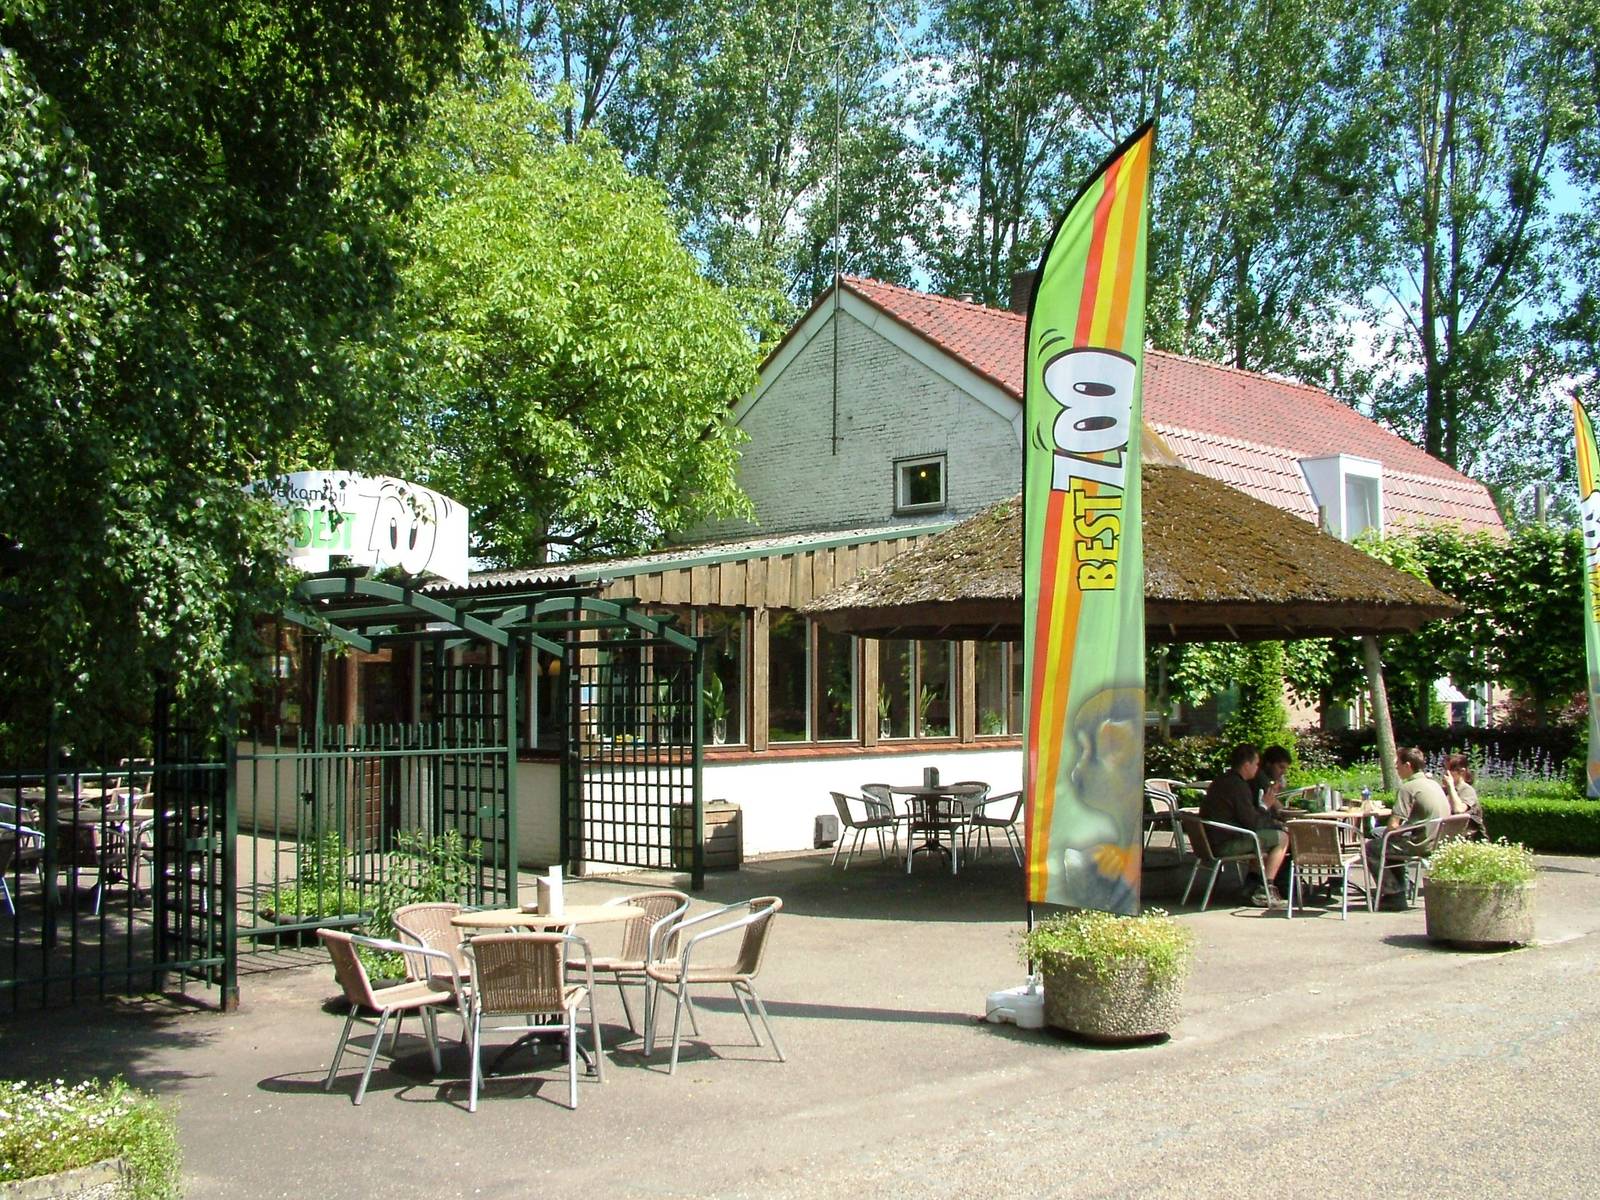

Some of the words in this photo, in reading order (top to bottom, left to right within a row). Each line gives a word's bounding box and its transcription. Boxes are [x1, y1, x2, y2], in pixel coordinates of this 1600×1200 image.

[1042, 347, 1137, 493] ZOO
[258, 481, 322, 501] Wekom
[1073, 488, 1122, 591] BEST
